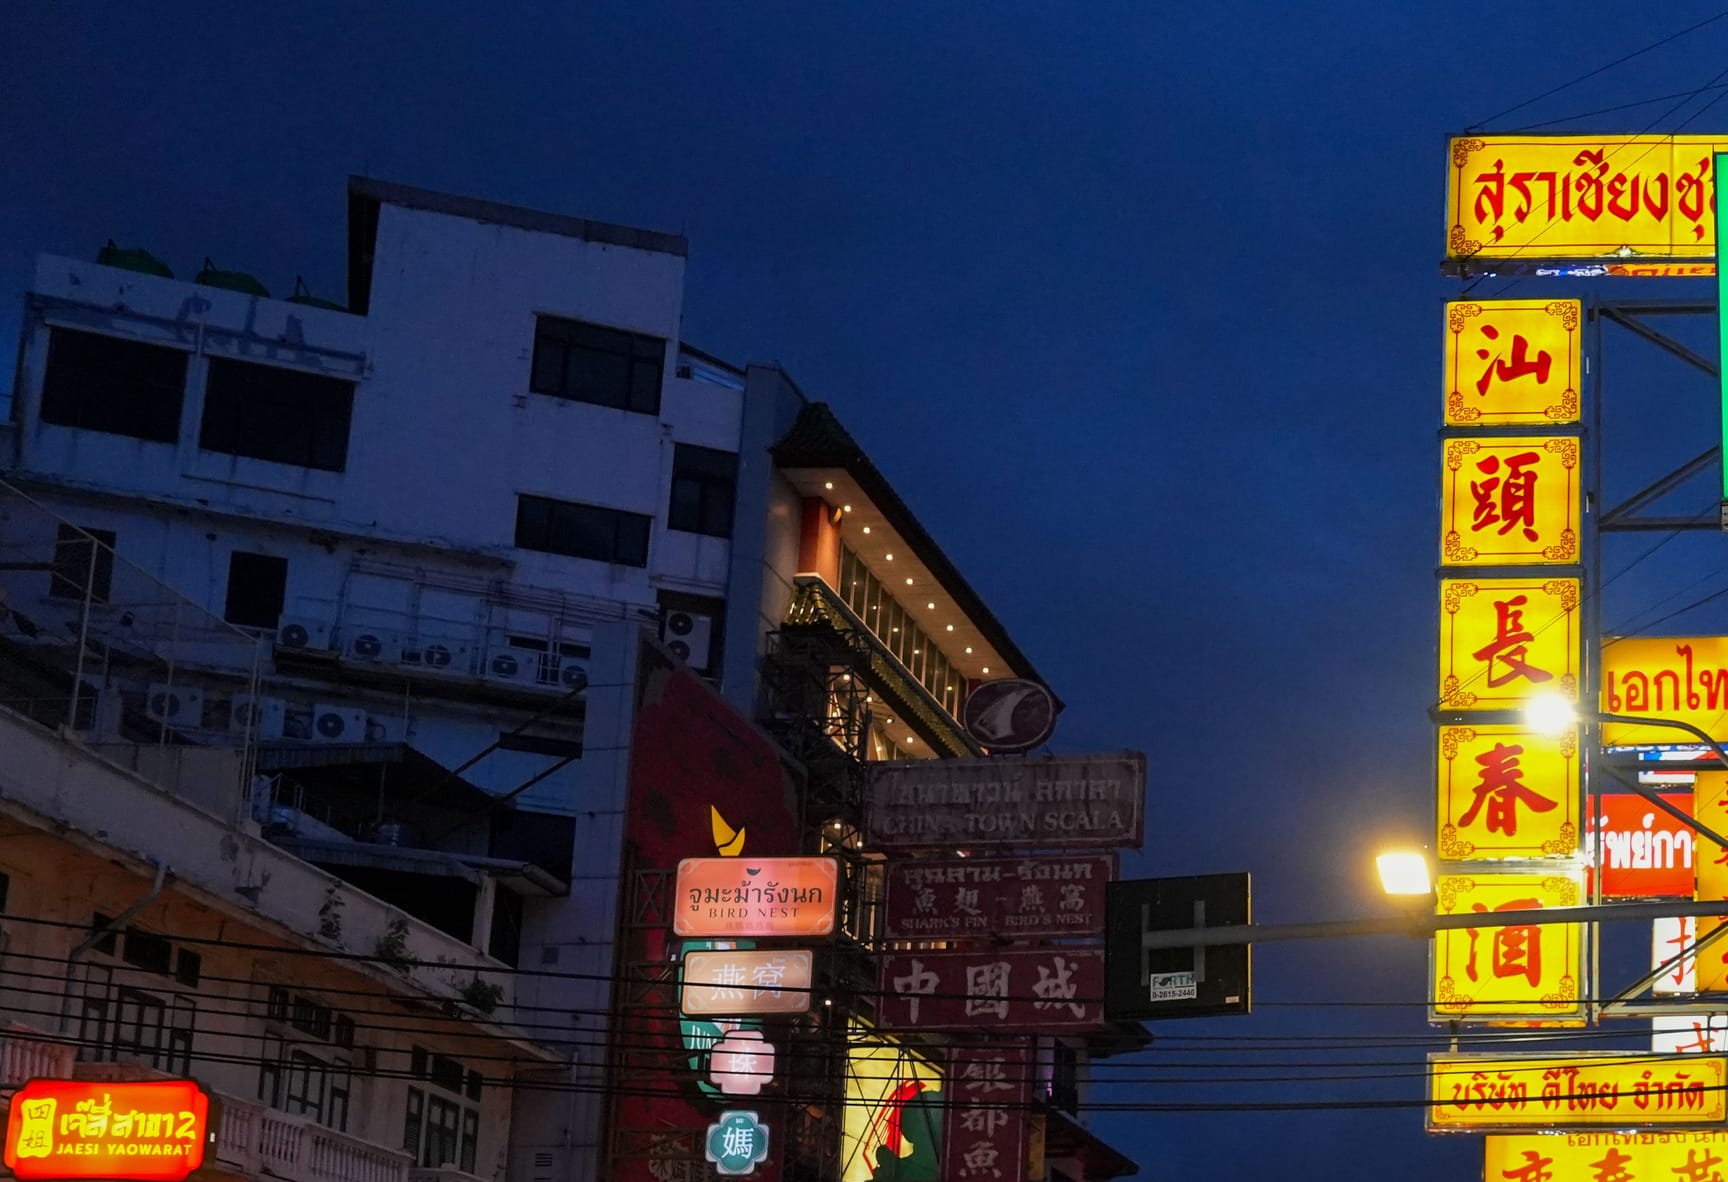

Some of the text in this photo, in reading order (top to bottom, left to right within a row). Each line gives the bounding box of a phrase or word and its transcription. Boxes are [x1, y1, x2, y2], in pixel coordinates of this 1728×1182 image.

[963, 812, 1036, 833] TOWN
[1044, 810, 1125, 831] SCALA
[689, 880, 823, 912] จูมะม้ารังนก
[709, 906, 800, 918] BIRD NEST
[893, 956, 1087, 1025] 中國城
[1634, 1070, 1705, 1111] จำกัด
[56, 1143, 193, 1156] JAESI YAOWARAT
[720, 1126, 754, 1160] 媽
